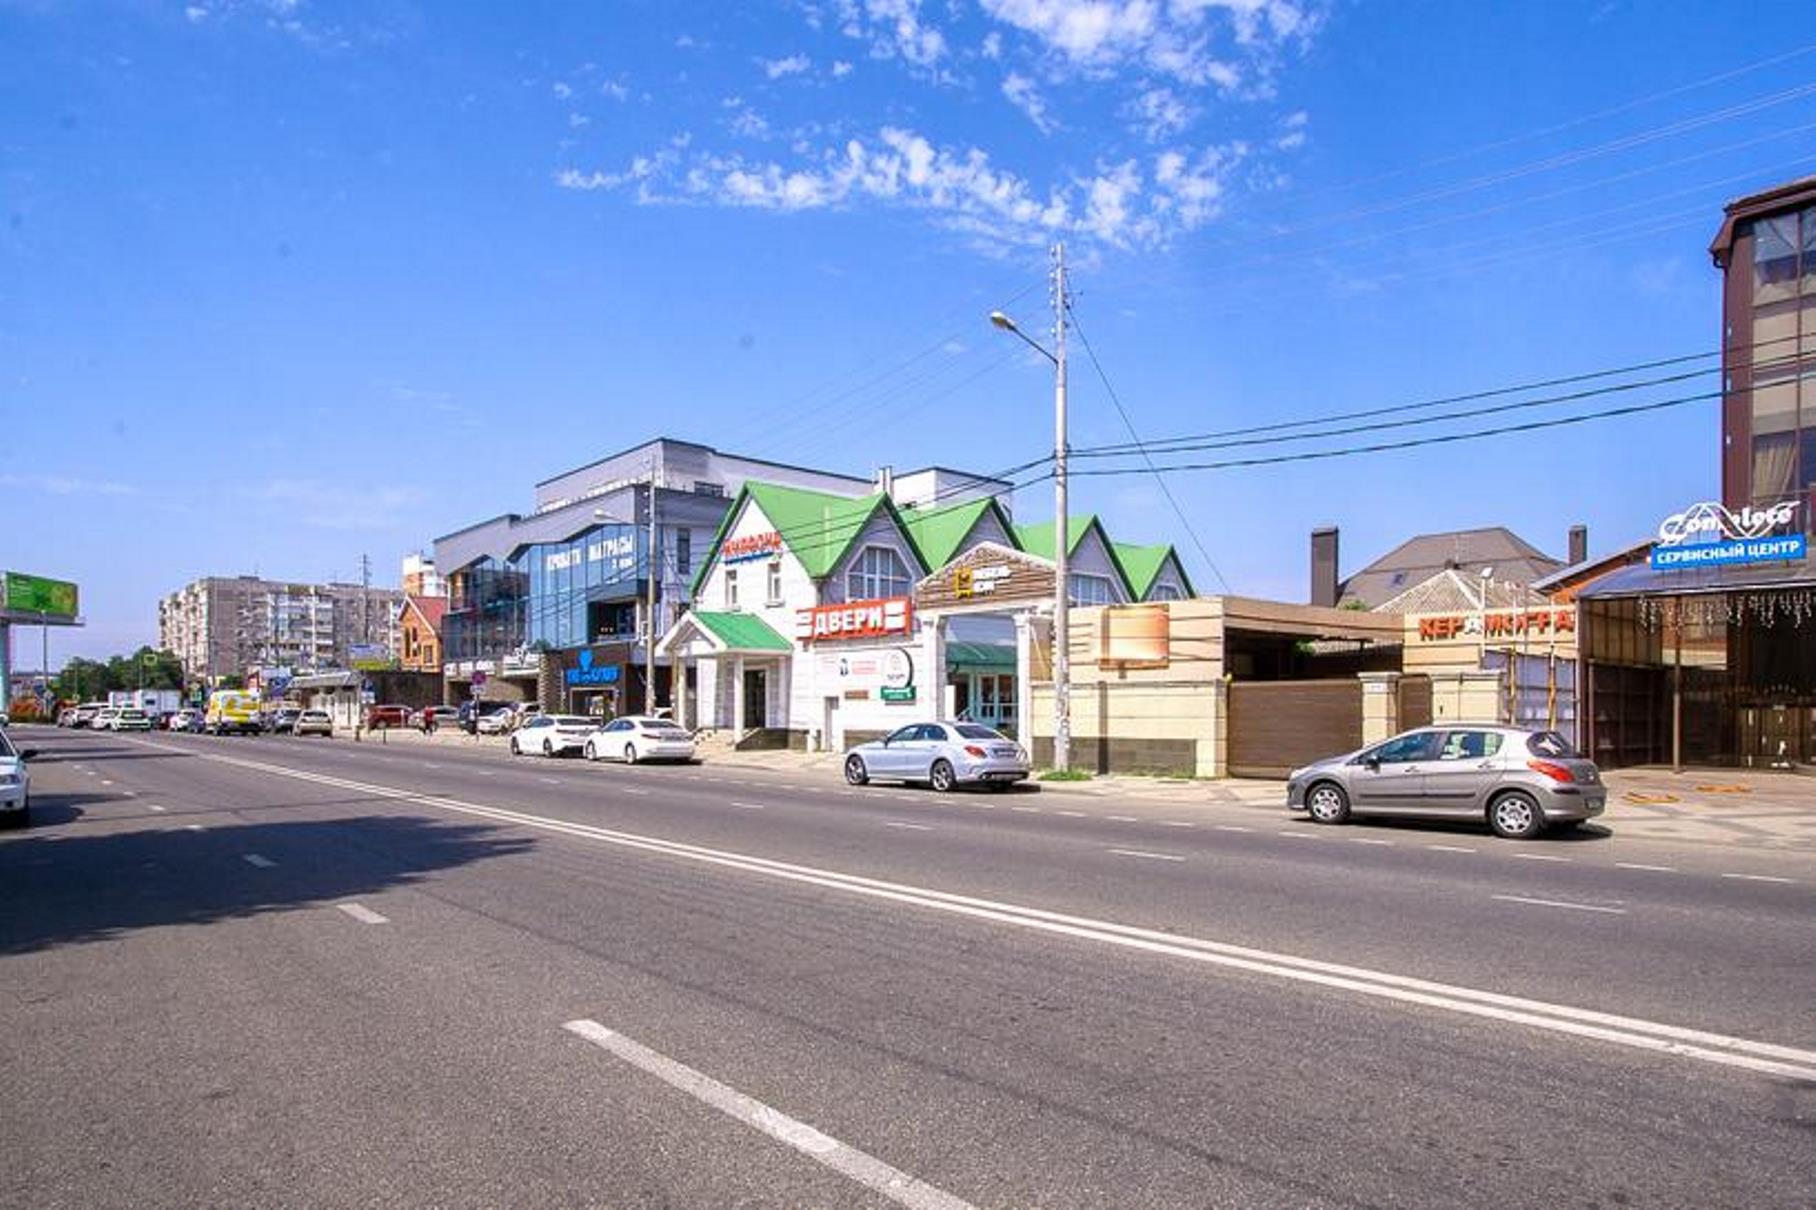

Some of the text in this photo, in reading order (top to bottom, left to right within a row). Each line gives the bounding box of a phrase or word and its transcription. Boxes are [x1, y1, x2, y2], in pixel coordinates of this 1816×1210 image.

[1656, 540, 1800, 564] СЕРВИСНЫЙ ЦЕНТР
[813, 605, 883, 635] ДВЕРИ
